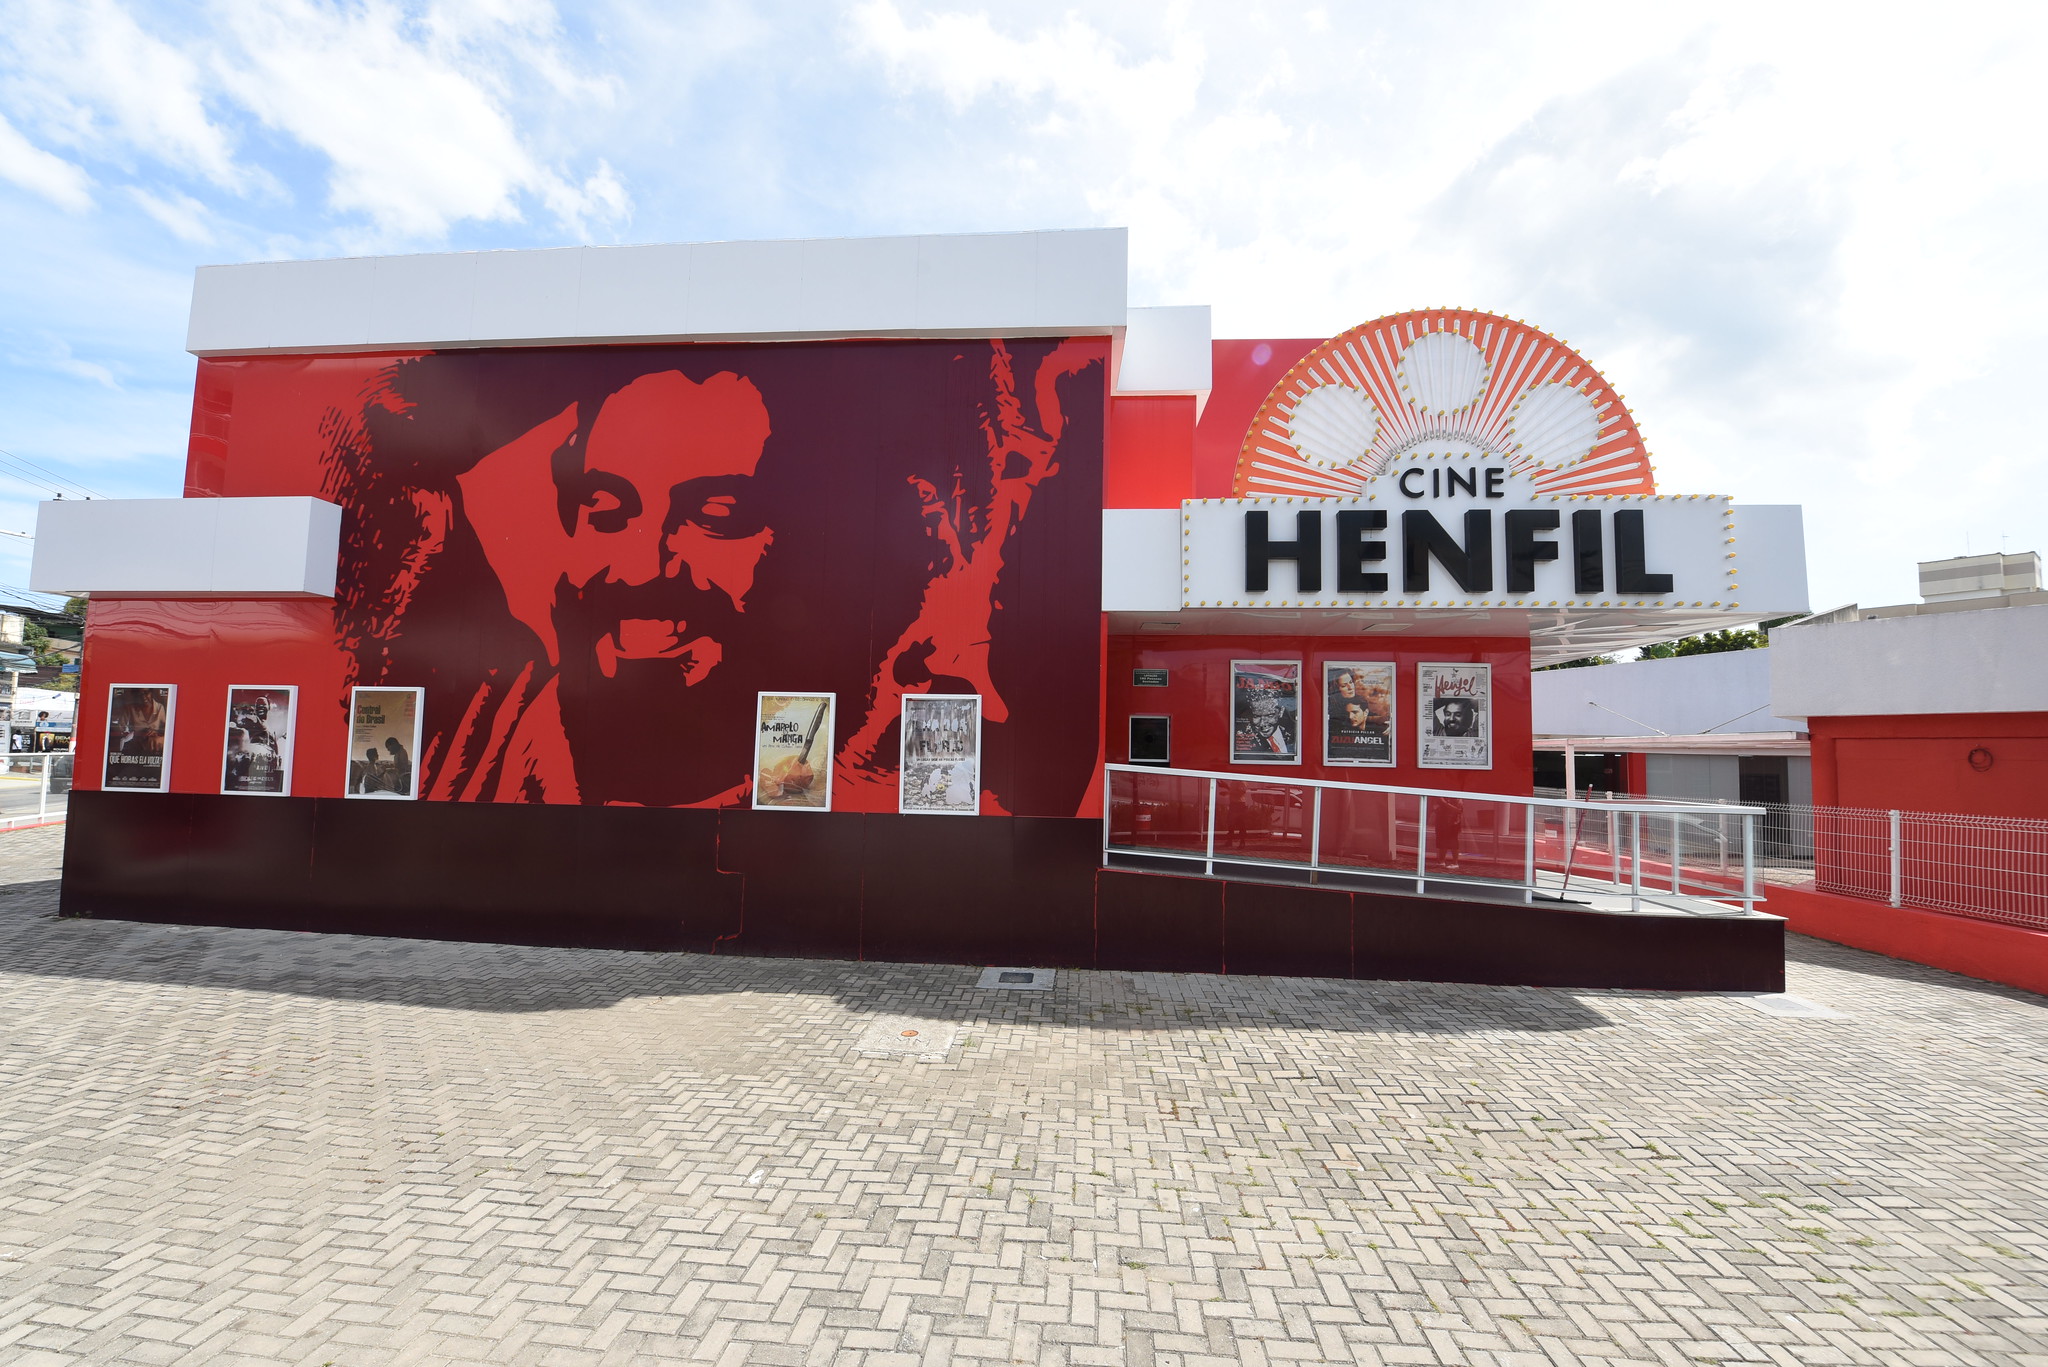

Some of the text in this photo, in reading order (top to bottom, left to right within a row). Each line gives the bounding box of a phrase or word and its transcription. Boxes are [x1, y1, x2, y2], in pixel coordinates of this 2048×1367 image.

[1400, 467, 1505, 499] CINE
[1244, 508, 1674, 594] HENFIL
[357, 704, 381, 714] Central
[366, 715, 386, 724] Brasil
[773, 734, 802, 744] MANGA
[110, 756, 120, 764] QUE
[120, 756, 138, 764] HORAS
